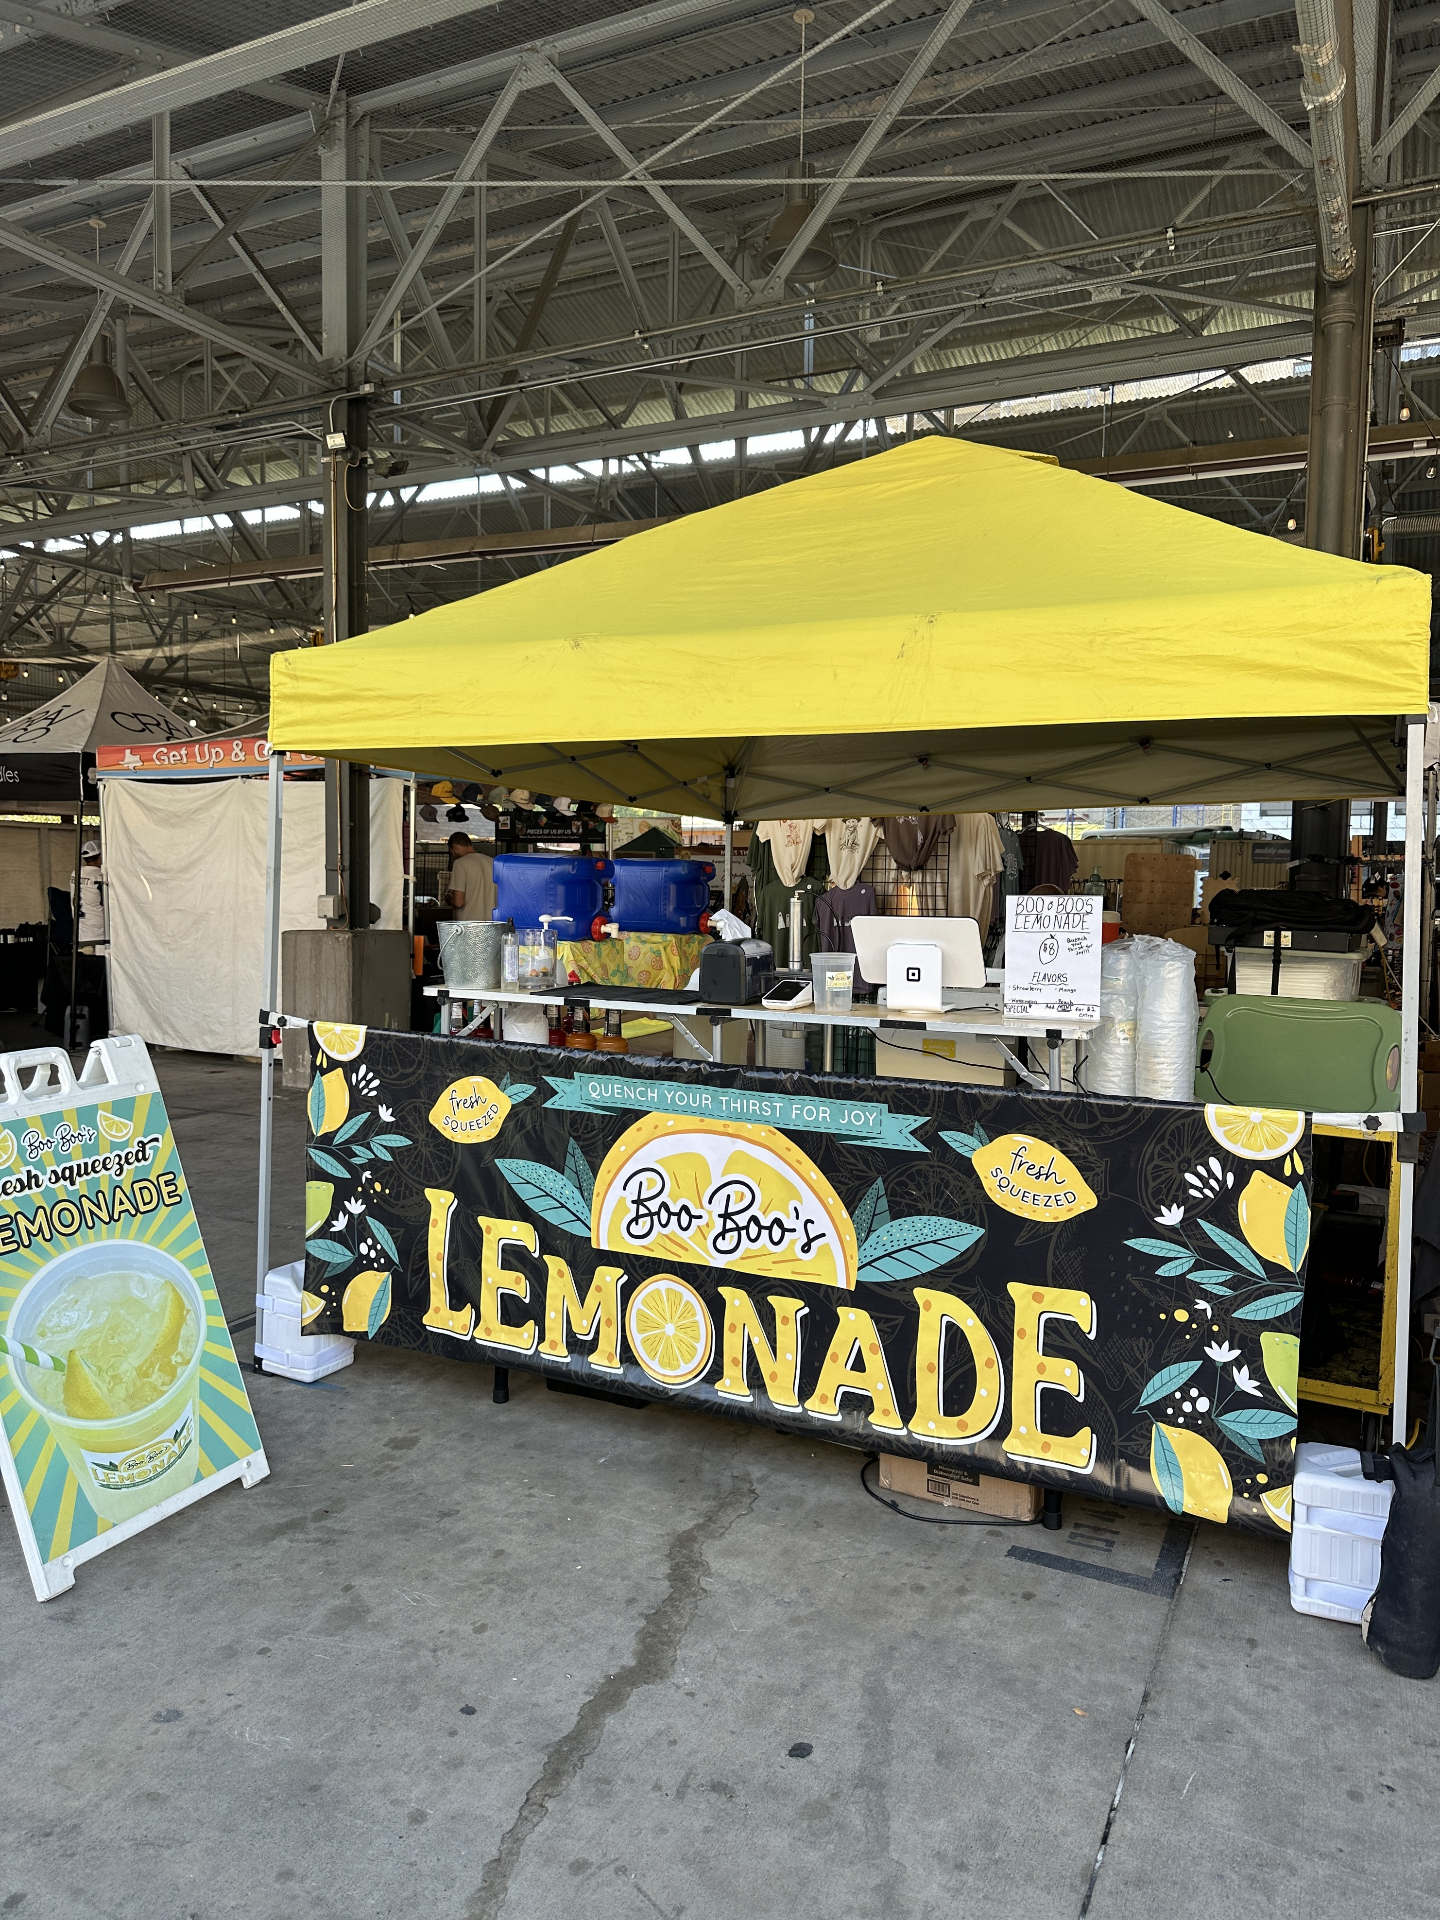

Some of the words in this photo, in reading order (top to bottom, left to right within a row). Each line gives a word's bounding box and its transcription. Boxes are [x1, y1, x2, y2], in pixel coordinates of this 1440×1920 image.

[152, 746, 188, 765] Get
[194, 743, 223, 768] Up
[231, 740, 246, 762] &
[1015, 897, 1045, 915] BOO
[1015, 913, 1090, 931] LEMONADE
[1043, 942, 1056, 956] $8
[1031, 971, 1068, 983] FLAVORS
[1006, 1004, 1030, 1014] SPECIAL
[442, 1103, 499, 1133] SQUEEZED
[448, 1084, 488, 1117] fresh
[588, 1081, 658, 1103] QUENCH
[664, 1090, 712, 1109] YOUR
[719, 1096, 783, 1118] THIRST
[791, 1104, 831, 1122] FOR
[839, 1109, 878, 1127] JOY
[23, 1130, 56, 1160] Boo
[55, 1123, 96, 1153] Boo's
[0, 1169, 44, 1198] esh
[48, 1137, 160, 1187] squeezed
[1010, 1145, 1067, 1185] fresh
[990, 1167, 1077, 1208] SQUEEZED
[622, 1167, 704, 1240] Boo
[707, 1179, 827, 1254] Boo's
[424, 1187, 1098, 1474] LEMONADE
[90, 1418, 193, 1484] LEMONADE
